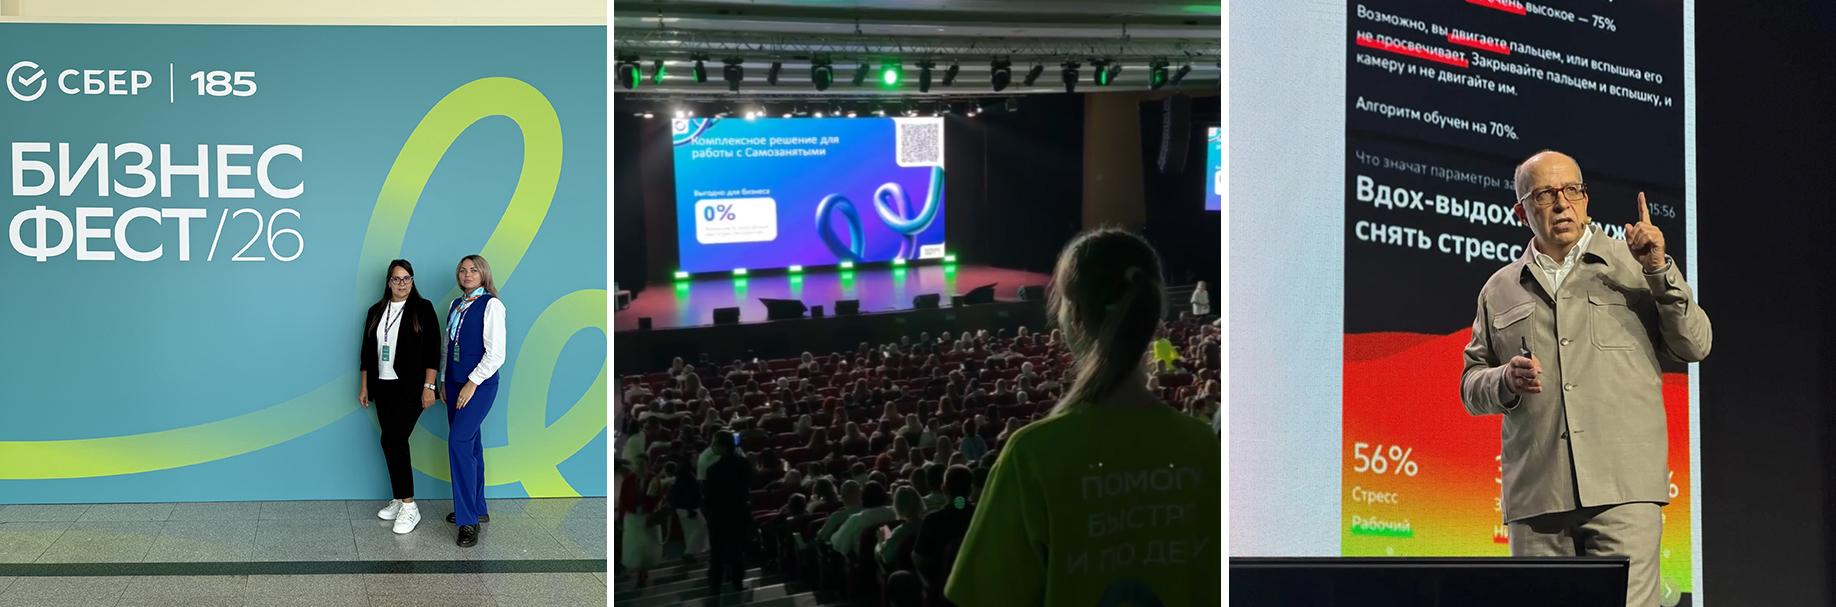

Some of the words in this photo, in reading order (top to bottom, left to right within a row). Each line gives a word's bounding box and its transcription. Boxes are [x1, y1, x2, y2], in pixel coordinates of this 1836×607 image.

[1526, 2, 1575, 22] высокое
[1592, 14, 1617, 32] 75%
[1357, 4, 1429, 34] Возможно,
[1432, 23, 1449, 36] вы
[1451, 28, 1508, 50] двигаете
[1510, 41, 1564, 64] пальцем,
[1567, 54, 1589, 67] или
[1591, 59, 1642, 80] вспышка
[1644, 70, 1663, 84] его
[57, 68, 152, 95] СБЕР
[190, 70, 257, 97] 185
[1357, 30, 1374, 42] не
[1471, 51, 1544, 80] Закрывайте
[1546, 71, 1597, 91] пальцем
[1599, 83, 1607, 93] и
[1610, 85, 1662, 107] вспышку,
[1664, 97, 1672, 107] и
[1357, 53, 1405, 75] камеру
[1408, 63, 1416, 74] и
[1419, 66, 1436, 79] не
[1438, 70, 1496, 92] двигайте
[1498, 83, 1518, 96] им.
[1355, 96, 1421, 120] Алгоритм
[1423, 110, 1469, 130] обучен
[1472, 121, 1487, 134] на
[1490, 121, 1519, 140] 70%.
[691, 135, 766, 147] Комплексное
[769, 136, 817, 147] решение
[820, 135, 839, 146] для
[692, 147, 734, 159] работы
[736, 149, 743, 158] с
[745, 147, 826, 158] Самозанятыми
[11, 142, 305, 199] БИЗНЕС
[1356, 150, 1381, 167] Что
[1383, 157, 1428, 175] значат
[1430, 165, 1501, 189] параметры
[694, 189, 726, 198] Выгодно
[727, 189, 739, 197] для
[741, 187, 770, 196] бизнеса
[703, 203, 736, 222] 0%
[1649, 202, 1676, 219] 15:56
[8, 205, 305, 262] ФЕСТ/26
[1355, 220, 1432, 250] снять
[1353, 442, 1419, 477] 56%
[1352, 486, 1399, 505] Стресс
[1087, 503, 1196, 537] БЫСТР
[1352, 515, 1411, 533] Рабочий
[1066, 551, 1088, 575] И
[1099, 543, 1137, 572] ПО
